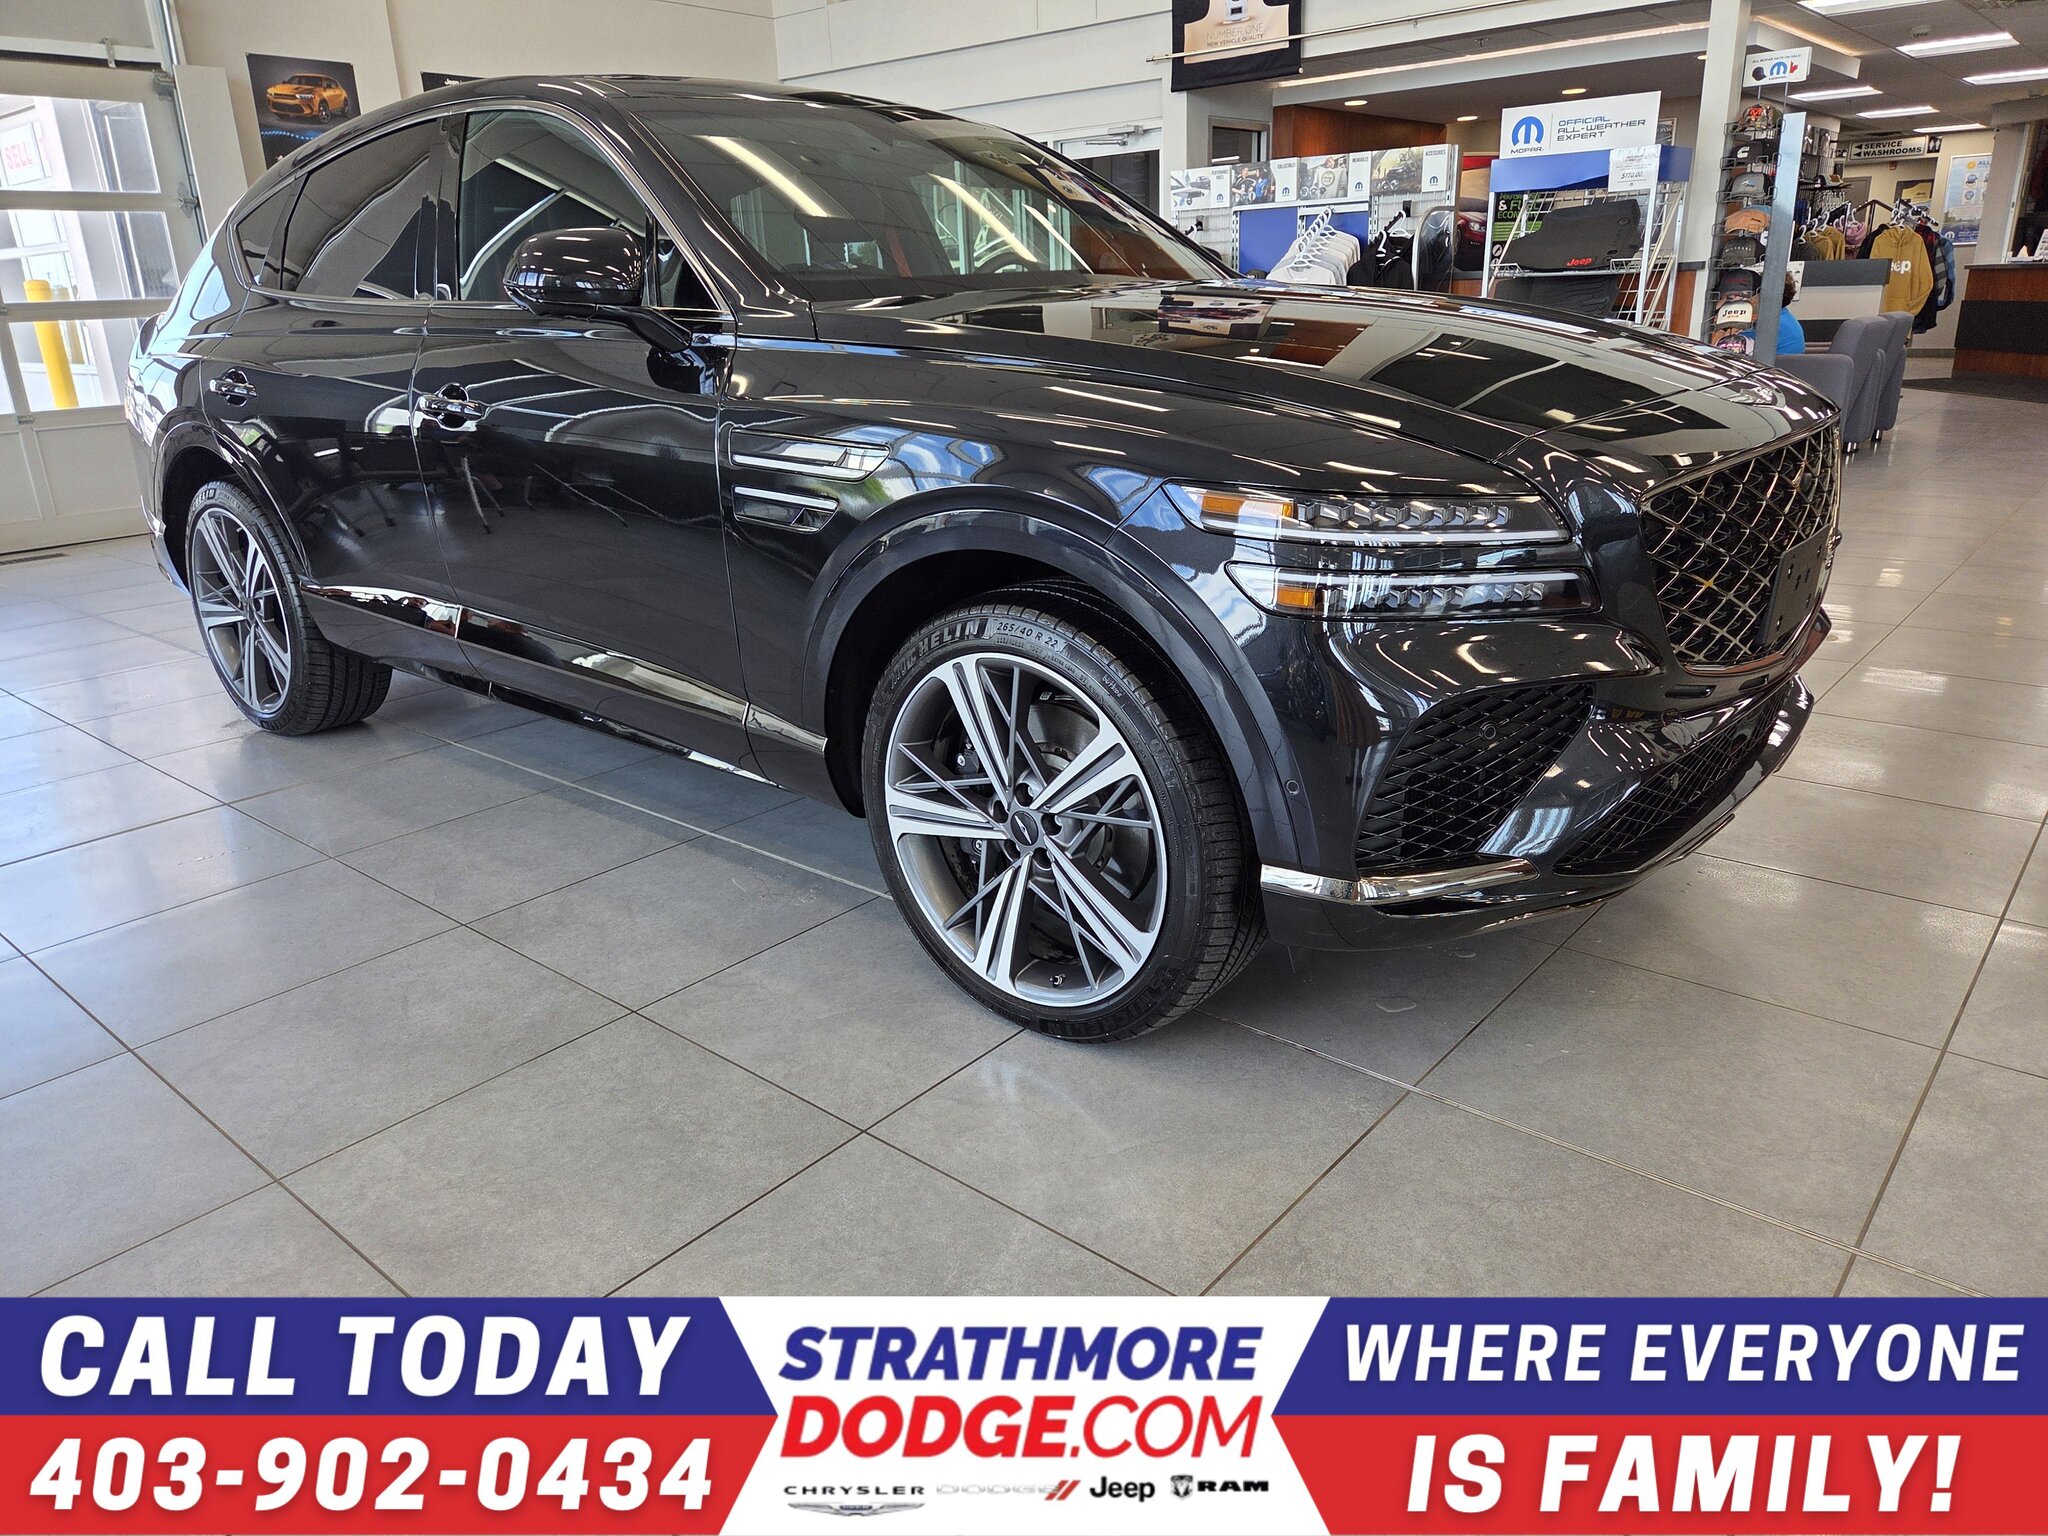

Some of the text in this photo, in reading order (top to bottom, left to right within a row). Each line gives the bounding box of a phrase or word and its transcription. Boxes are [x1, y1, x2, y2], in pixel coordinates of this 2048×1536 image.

[1206, 22, 1264, 40] NUMBER ONE
[1220, 37, 1241, 46] VEHICLE
[1241, 33, 1264, 42] QUALITY
[1557, 119, 1646, 134] ALL-WEATHER
[1558, 115, 1611, 127] OFFICIAL
[1557, 131, 1606, 142] EXPERT
[1864, 140, 1903, 150] SERVICE
[1863, 146, 1922, 157] WASHROOMS
[1498, 200, 1508, 211] &
[1566, 256, 1593, 267] Jeep
[997, 621, 1034, 638] 265/40
[1035, 633, 1043, 642] R
[1044, 636, 1059, 650] 22
